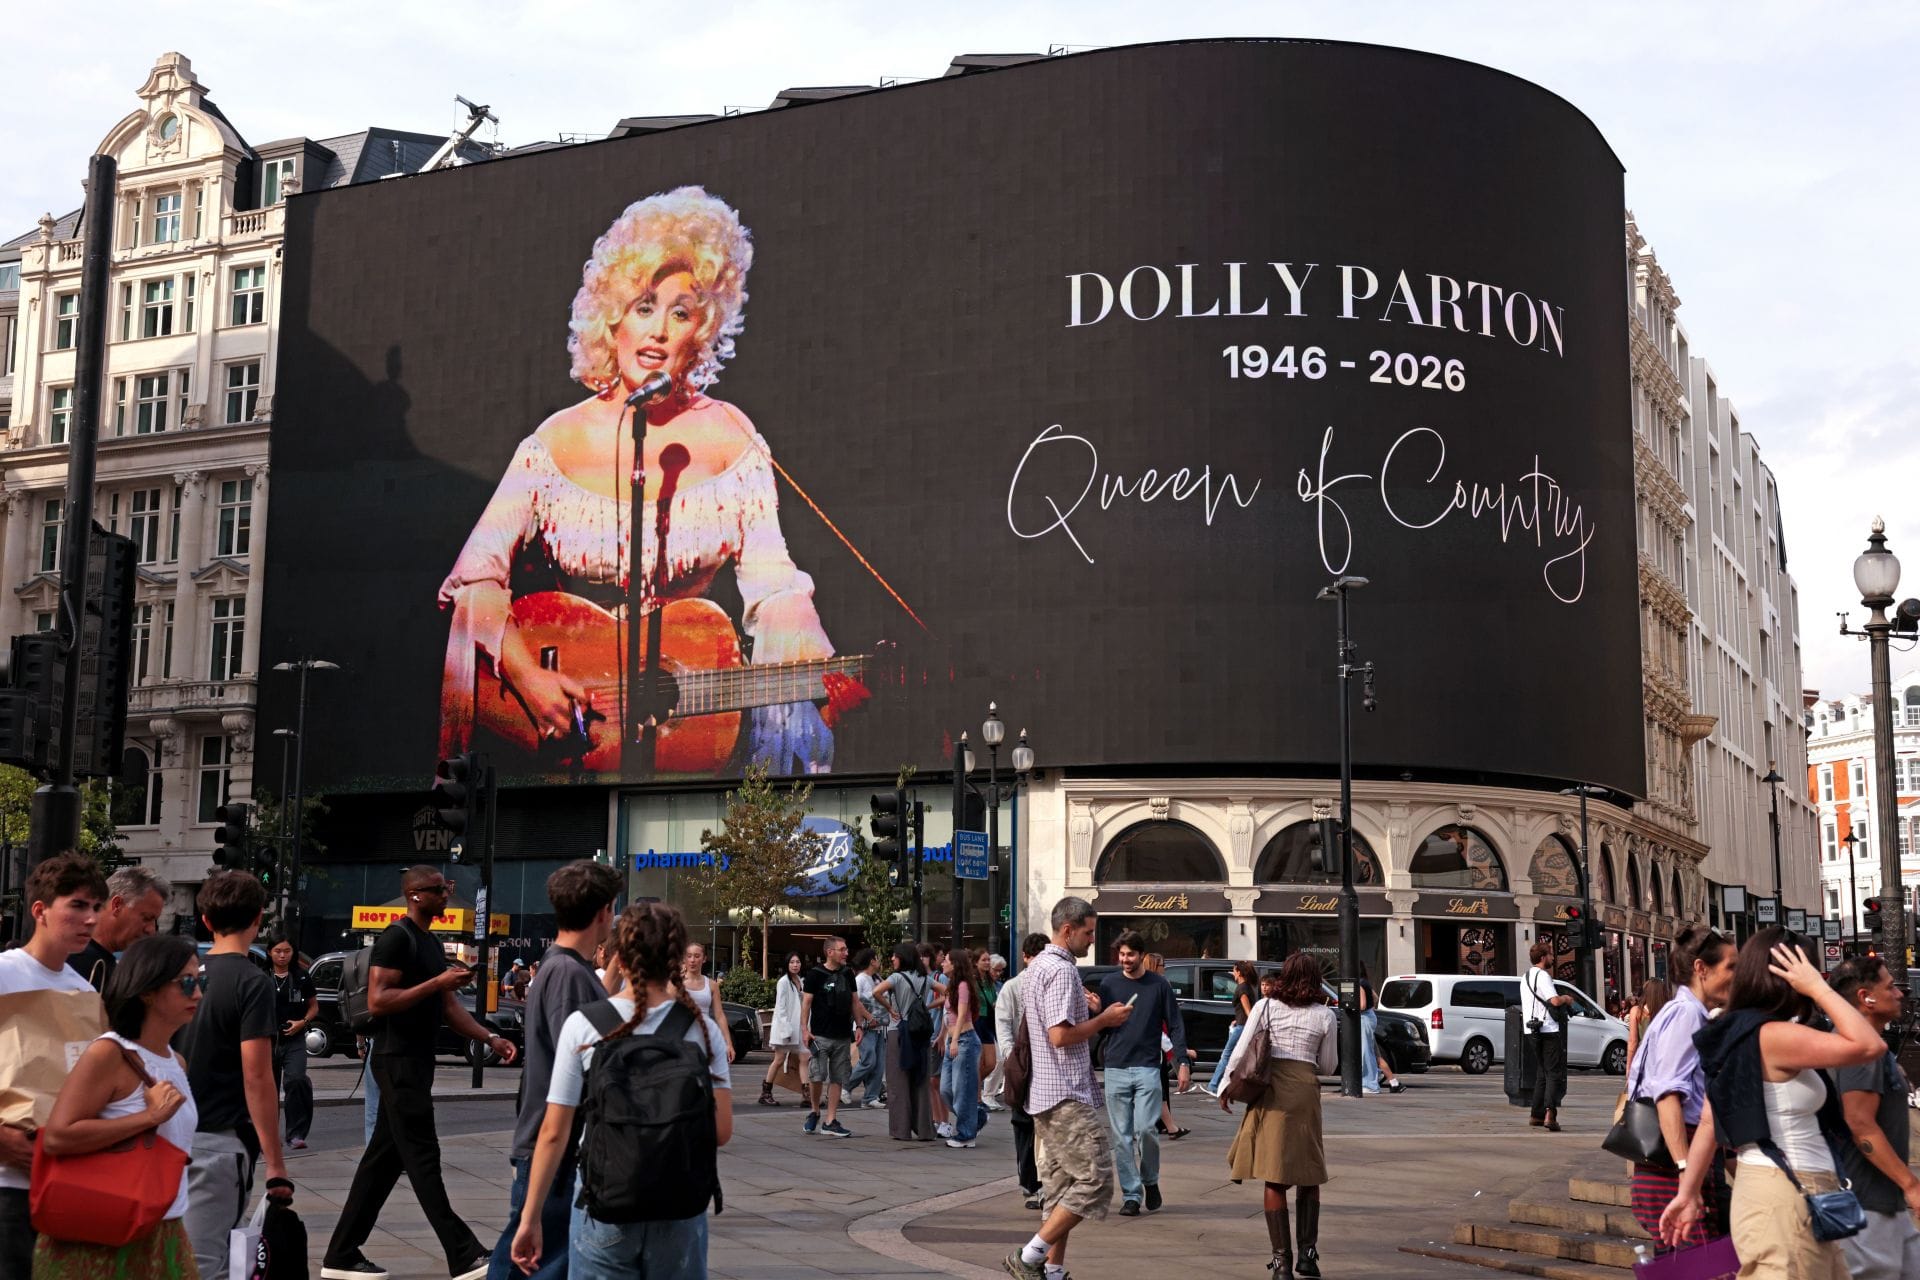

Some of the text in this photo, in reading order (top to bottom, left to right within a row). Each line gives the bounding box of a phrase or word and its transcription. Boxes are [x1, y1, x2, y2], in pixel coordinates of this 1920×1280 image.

[1064, 262, 1565, 358] DOLLY PARTON
[1222, 345, 1328, 380] 1946
[1368, 350, 1466, 392] 2026
[1007, 424, 1595, 603] Queen of Country
[959, 833, 985, 843] BUS LANE
[1133, 894, 1178, 910] Lindt
[1295, 895, 1339, 911] Lindt
[1445, 898, 1480, 914] Lindt
[358, 912, 456, 924] HOT DO POT
[1552, 904, 1570, 920] Lin
[539, 937, 555, 949] TH
[257, 1242, 267, 1269] HOP
